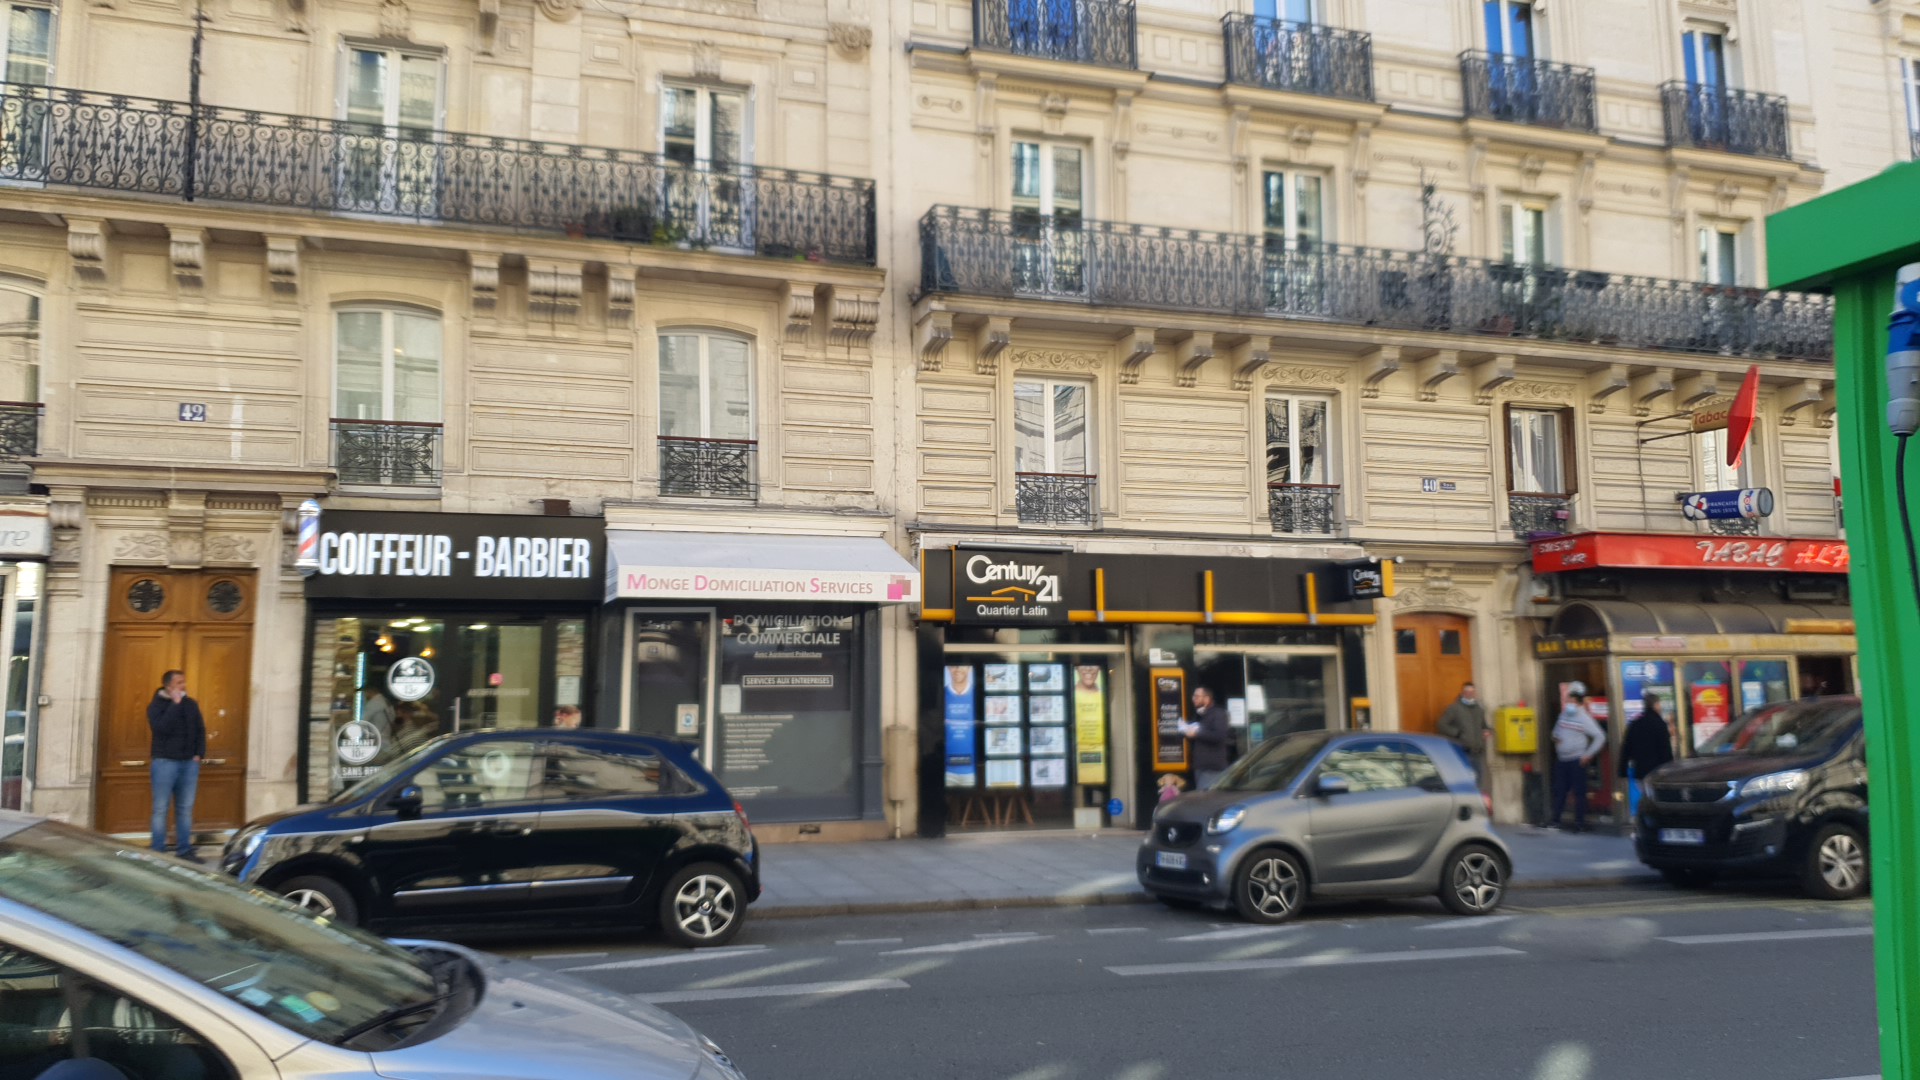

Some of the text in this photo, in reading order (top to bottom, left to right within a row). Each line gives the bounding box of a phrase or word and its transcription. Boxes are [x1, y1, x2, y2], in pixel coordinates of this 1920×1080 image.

[181, 404, 204, 421] 42
[1693, 411, 1728, 425] Tabac
[1423, 479, 1436, 491] 40
[319, 532, 450, 576] COIFFEUR
[475, 536, 591, 579] BARBIER
[1696, 541, 1785, 567] TABAC
[966, 555, 1044, 585] Century
[627, 574, 689, 590] MONGE
[694, 575, 806, 593] DOMICILIATION
[810, 577, 873, 594] SERVICES
[1036, 575, 1059, 602] 21
[977, 605, 1048, 617] Quartier Latin
[734, 615, 844, 627] DOMICILIATION
[736, 632, 841, 645] COMMERCIALE
